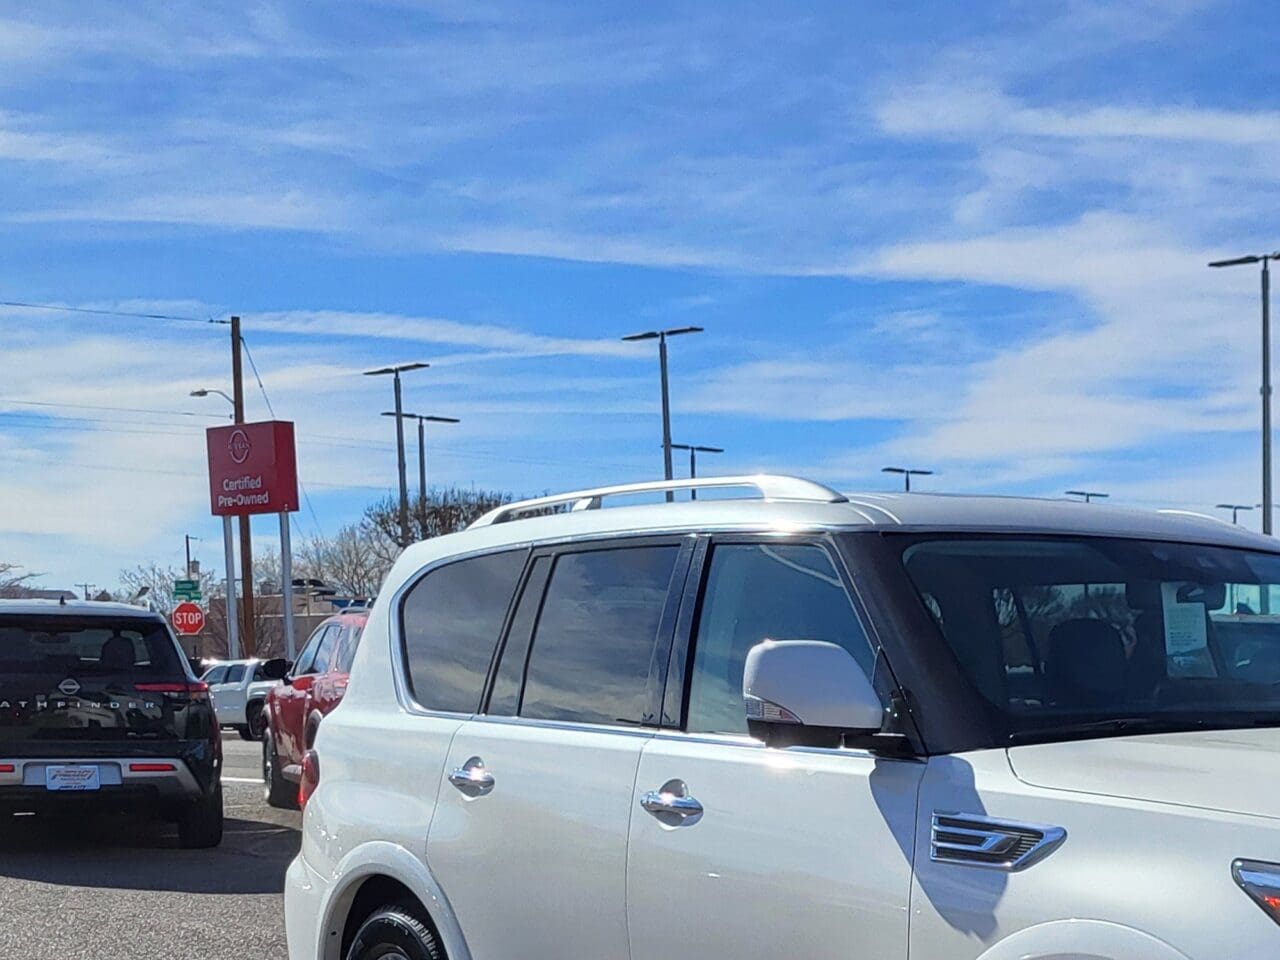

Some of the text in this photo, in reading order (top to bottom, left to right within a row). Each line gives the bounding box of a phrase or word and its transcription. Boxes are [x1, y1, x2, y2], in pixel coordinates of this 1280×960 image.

[222, 475, 262, 492] Certified
[218, 491, 269, 507] Pre-Owned
[175, 612, 202, 625] STOP
